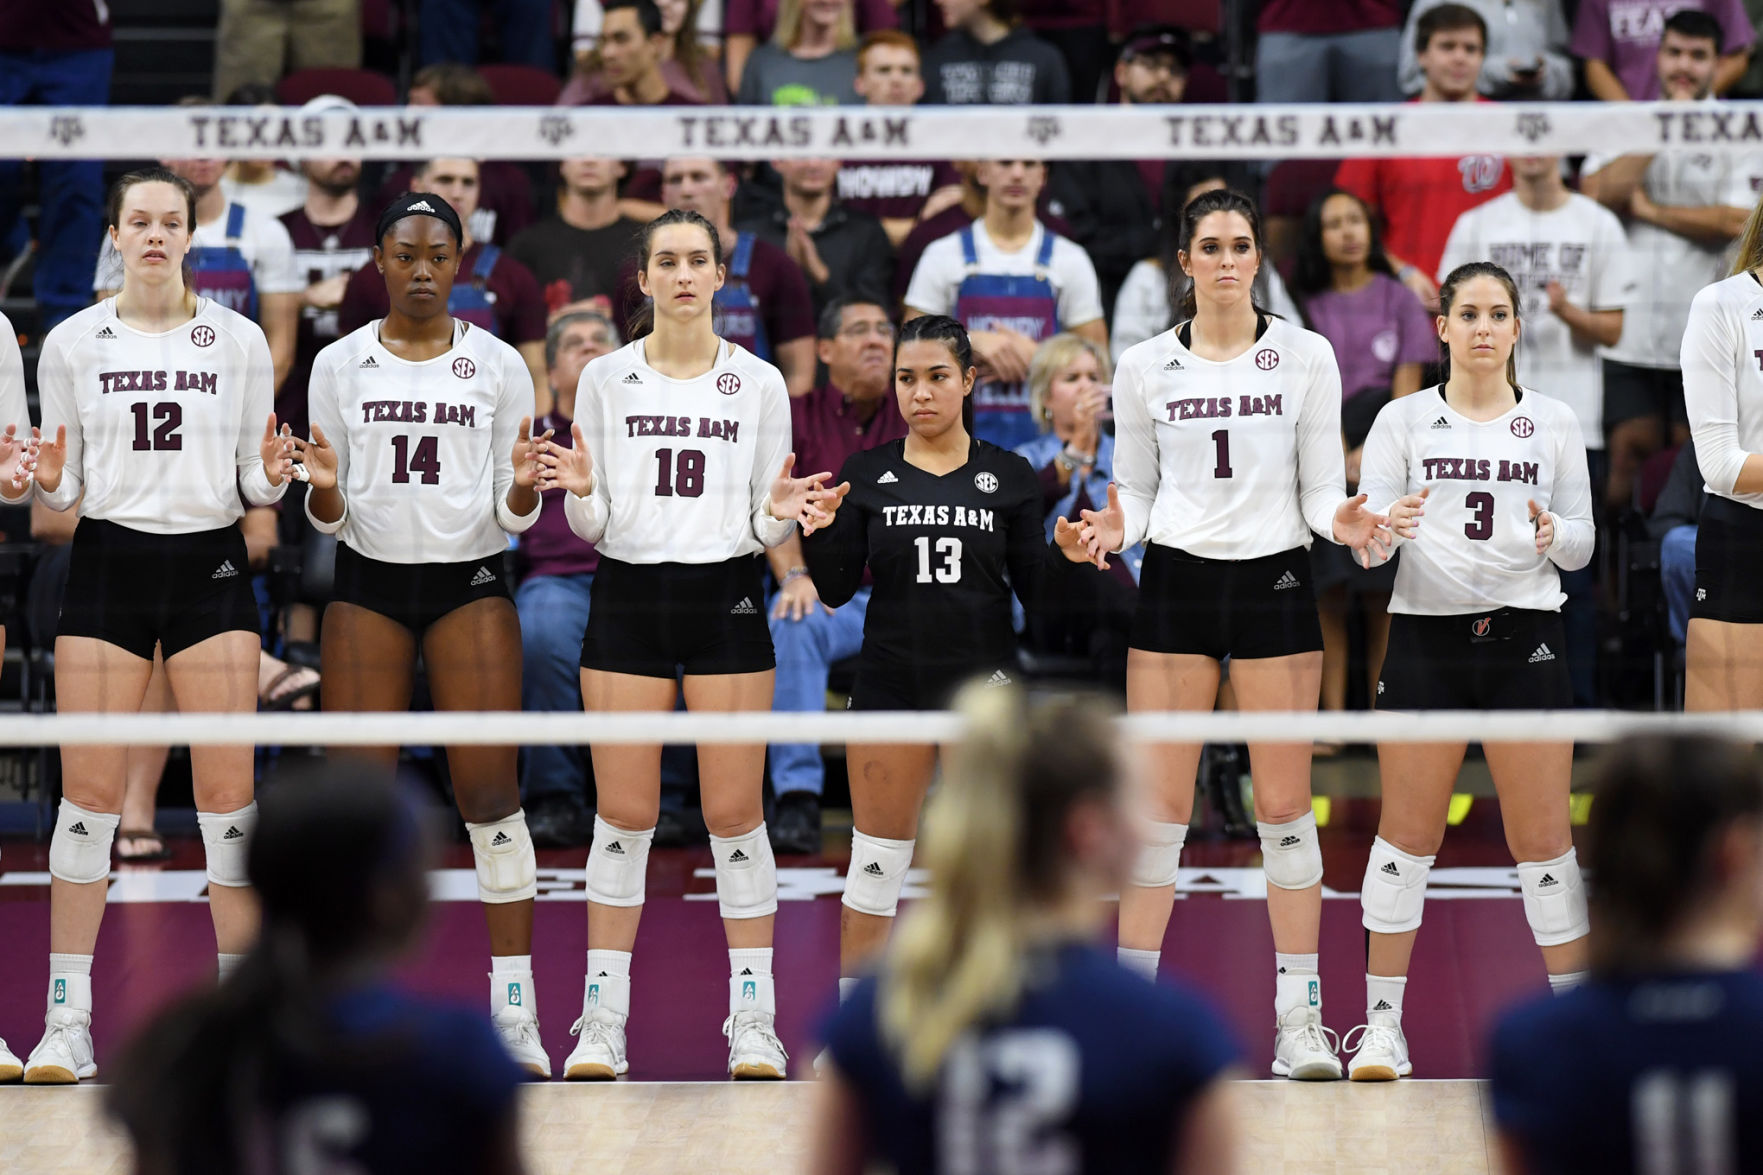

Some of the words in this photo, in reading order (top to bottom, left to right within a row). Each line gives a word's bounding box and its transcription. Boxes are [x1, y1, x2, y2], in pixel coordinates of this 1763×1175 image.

[1609, 6, 1676, 41] FEA
[191, 116, 324, 148] TEXAS
[345, 116, 425, 148] A&M
[679, 116, 810, 147] TEXAS
[832, 116, 911, 147] A&M
[1167, 114, 1298, 146] TEXAS
[1318, 114, 1398, 145] A&M
[1656, 111, 1763, 141] TEXA
[192, 328, 214, 345] SEC
[453, 359, 475, 376] SEC
[1256, 352, 1278, 368] SEC
[99, 371, 168, 395] TEXAS
[174, 371, 219, 395] A&M
[717, 376, 740, 392] SEC
[361, 400, 428, 424] TEXAS
[433, 401, 476, 428] A&M
[1166, 396, 1232, 421] TEXAS
[1238, 394, 1283, 416] A&M
[130, 402, 183, 451] 12
[625, 415, 691, 438] TEXAS
[696, 417, 739, 443] A&M
[1510, 419, 1534, 436] SEC
[391, 435, 442, 486] 14
[1211, 429, 1233, 479] 1
[655, 448, 706, 498] 18
[1422, 457, 1491, 481] TEXAS
[1495, 460, 1540, 485] A&M
[975, 475, 998, 490] SEC
[882, 505, 949, 527] TEXAS
[953, 506, 994, 533] A&M
[1464, 491, 1495, 541] 3
[914, 536, 963, 585] 13
[211, 570, 240, 580] adidas
[470, 575, 497, 586] adidas
[1273, 581, 1301, 592] adidas
[730, 607, 758, 615] adidas
[1528, 653, 1556, 663] adidas
[68, 827, 89, 837] adidas
[223, 832, 244, 841] adidas
[491, 838, 512, 847] adidas
[1279, 837, 1301, 847] adidas
[605, 847, 626, 856] adidas
[728, 855, 749, 864] adidas
[863, 868, 884, 877] adidas
[1381, 868, 1401, 877] adidas
[1538, 880, 1559, 888] adidas
